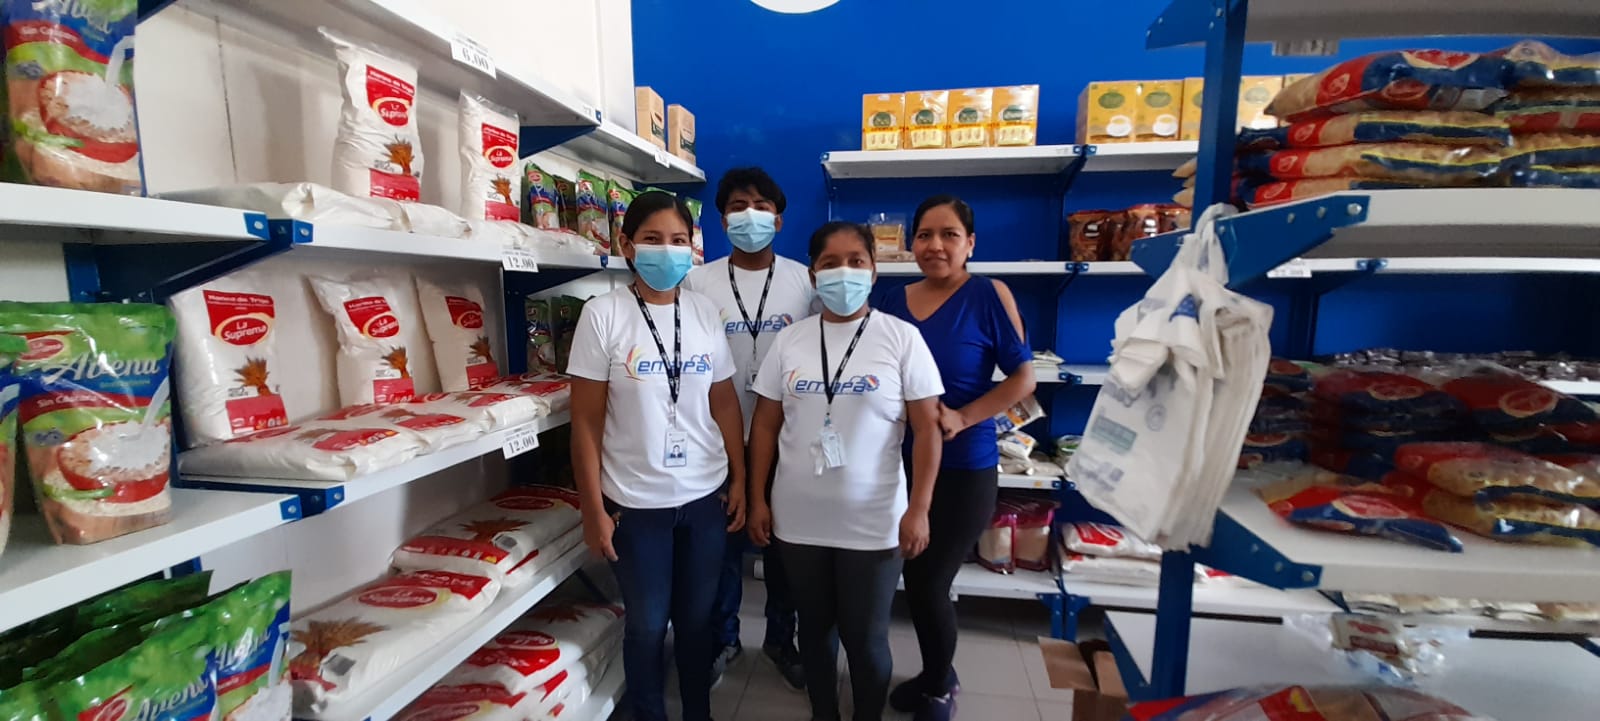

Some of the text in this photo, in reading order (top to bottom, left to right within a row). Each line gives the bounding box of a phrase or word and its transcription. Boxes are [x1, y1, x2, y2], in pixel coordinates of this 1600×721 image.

[462, 47, 489, 70] 6.00
[508, 255, 535, 269] 12.00
[208, 294, 236, 302] Harina
[236, 321, 248, 330] La
[370, 320, 399, 336] Suprema
[379, 318, 388, 326] La
[223, 325, 267, 341] Suprema
[42, 352, 159, 384] Avena
[508, 435, 535, 454] 12.00
[215, 630, 271, 671] Avna
[132, 675, 209, 721] Avena
